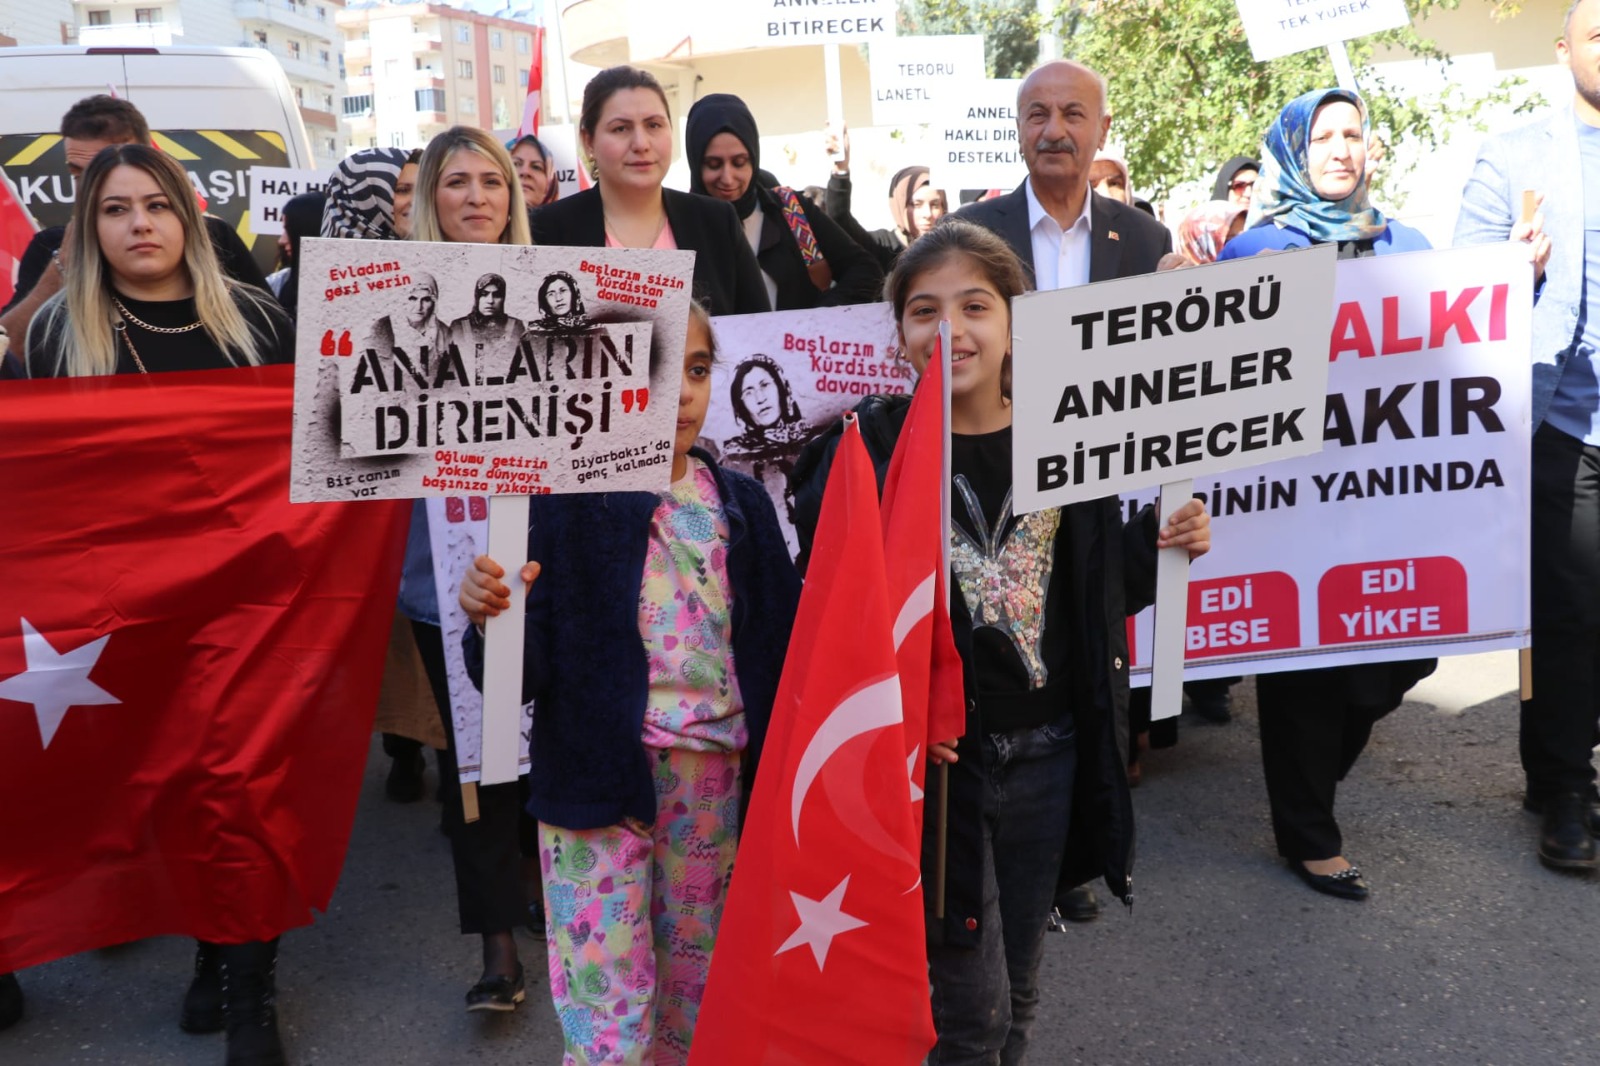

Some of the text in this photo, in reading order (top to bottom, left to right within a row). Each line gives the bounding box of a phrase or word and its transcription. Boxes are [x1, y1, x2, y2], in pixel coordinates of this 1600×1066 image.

[1278, 15, 1310, 30] TEK
[877, 88, 931, 101] LANETL
[967, 107, 1017, 119] ANNEL
[945, 127, 1017, 141] HAKLI DİR
[261, 180, 298, 196] HA!
[556, 169, 577, 182] UZ
[9, 175, 77, 204] KU
[329, 261, 401, 282] Evladımı
[580, 260, 684, 289] Başlarım sizin
[324, 274, 411, 302] geri verin
[597, 289, 658, 308] davanıza
[1071, 274, 1281, 350] TERÖRÜ
[1328, 283, 1509, 362] ALKI
[783, 333, 875, 358] Başlarım
[1053, 347, 1293, 423] ANNELER
[1323, 376, 1506, 447] AKIR
[435, 450, 548, 470] Oğlumu getirin
[1037, 407, 1306, 492] BİTİRECEK
[326, 469, 401, 488] Bir canım
[436, 465, 541, 483] yoksa dünyayı
[577, 454, 668, 484] genç kalmadı
[1311, 459, 1505, 503] YANINDA
[351, 486, 378, 498] var
[422, 475, 552, 495] başınıza yıkarım
[1361, 560, 1416, 595] EDİ
[1201, 578, 1253, 614] EDİ
[1339, 605, 1441, 637] YİKFE
[1186, 618, 1270, 651] BESE
